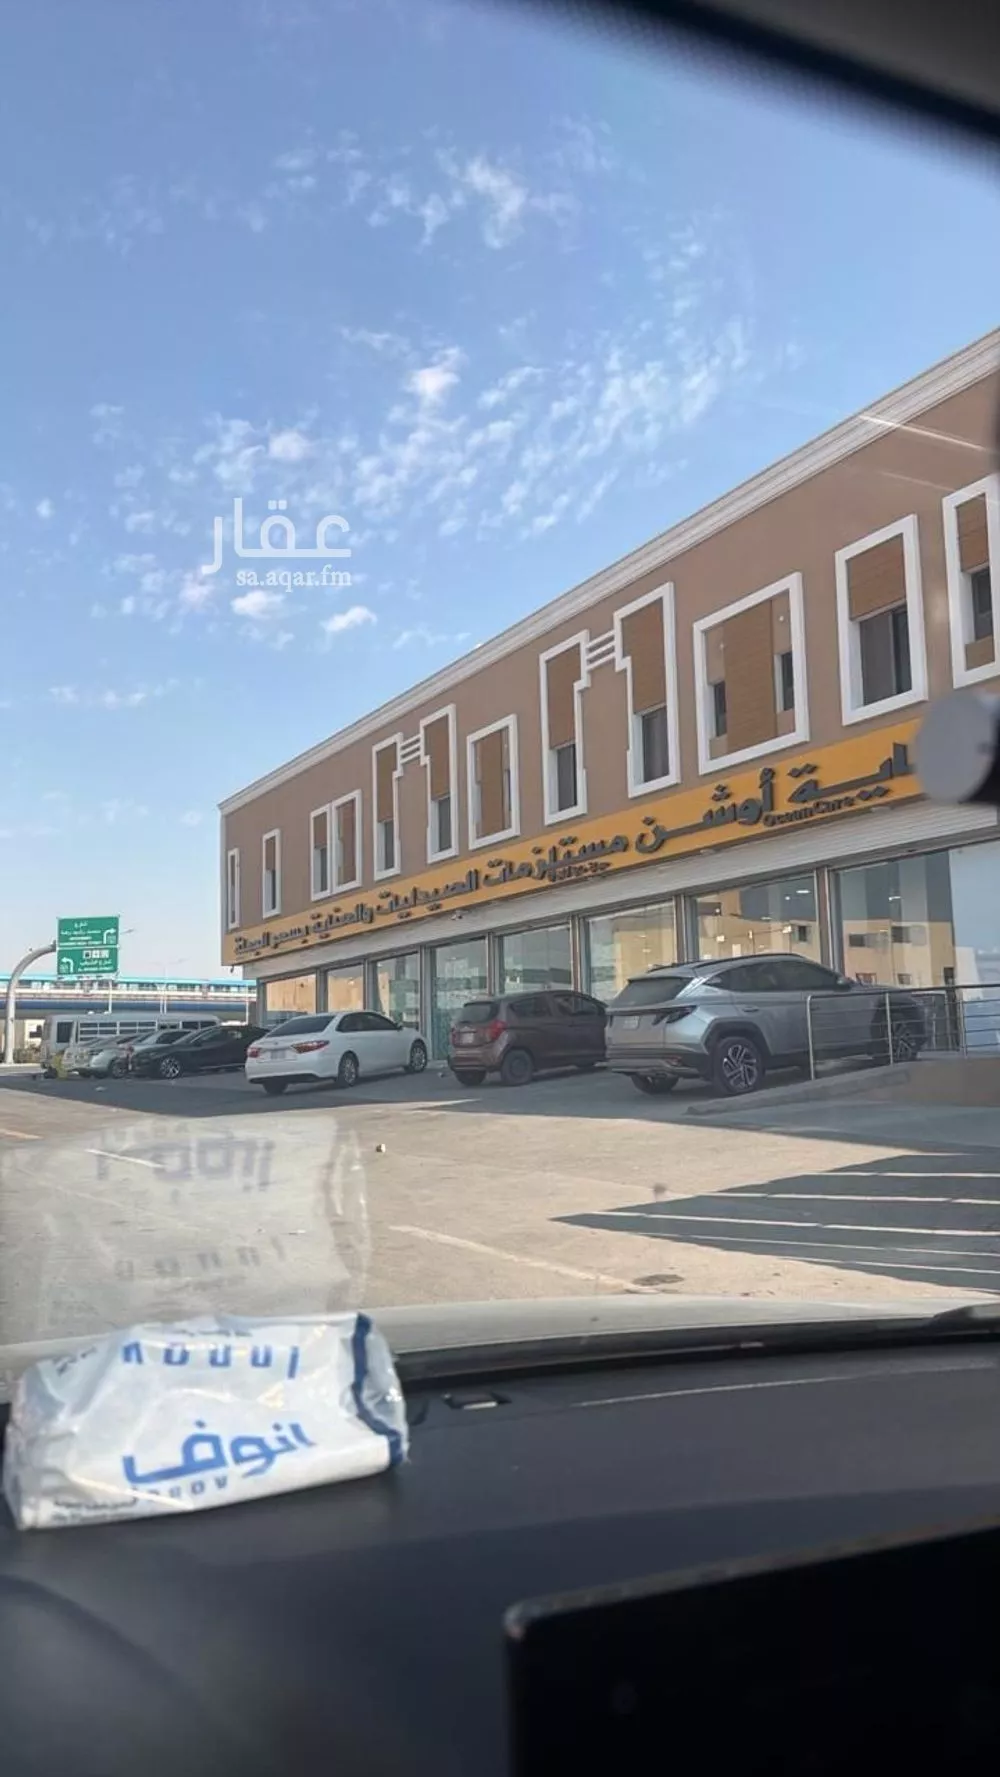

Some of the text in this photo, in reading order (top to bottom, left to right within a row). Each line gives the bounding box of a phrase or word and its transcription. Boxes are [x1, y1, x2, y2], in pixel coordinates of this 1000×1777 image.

[634, 767, 777, 854] أوشن
[483, 834, 630, 887] مستلزمات
[375, 868, 480, 920] الصيدليات
[122, 1419, 318, 1485] انوف
